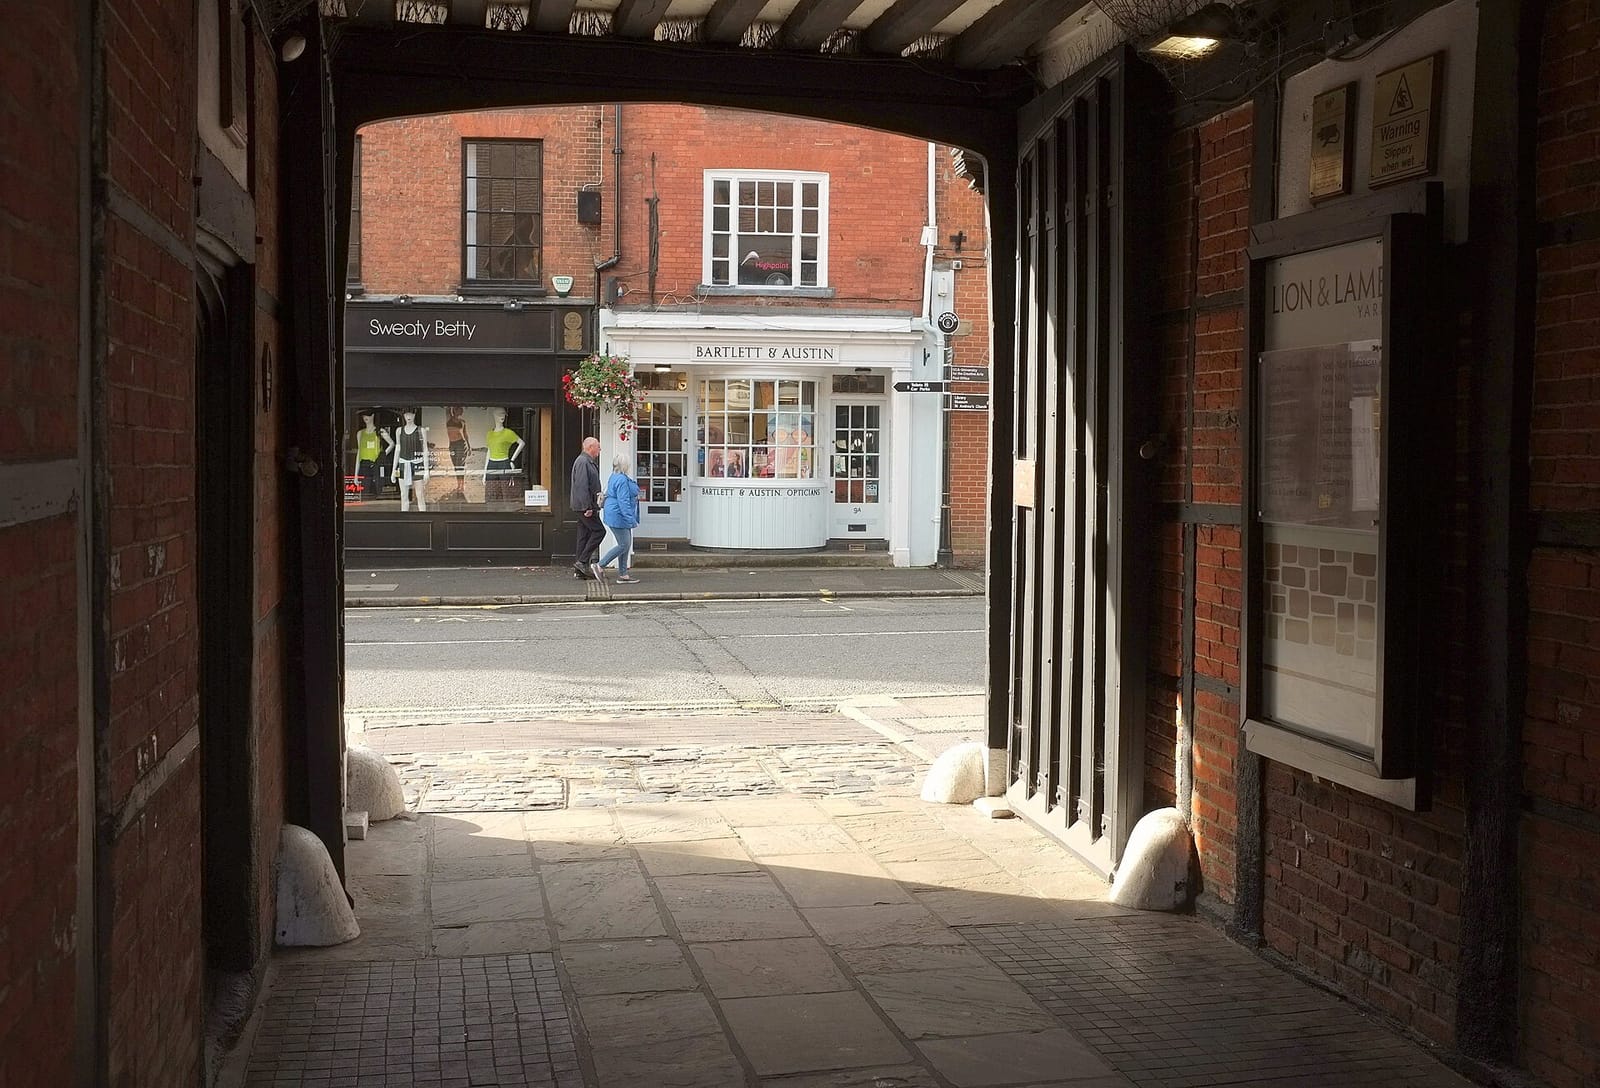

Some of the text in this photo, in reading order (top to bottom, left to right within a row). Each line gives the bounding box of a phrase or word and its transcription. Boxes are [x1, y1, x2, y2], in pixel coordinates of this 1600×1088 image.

[1380, 117, 1421, 142] Warning
[1384, 143, 1413, 160] Slippery
[1381, 155, 1415, 175] when wet
[1272, 279, 1313, 314] LION
[1317, 276, 1330, 307] &
[369, 318, 477, 340] Sweaty Betty
[695, 345, 834, 360] BARTLETT & AUSTIN
[701, 487, 734, 496] BARTLETT
[786, 488, 821, 497] OPTICIANS
[852, 506, 862, 514] 9A
